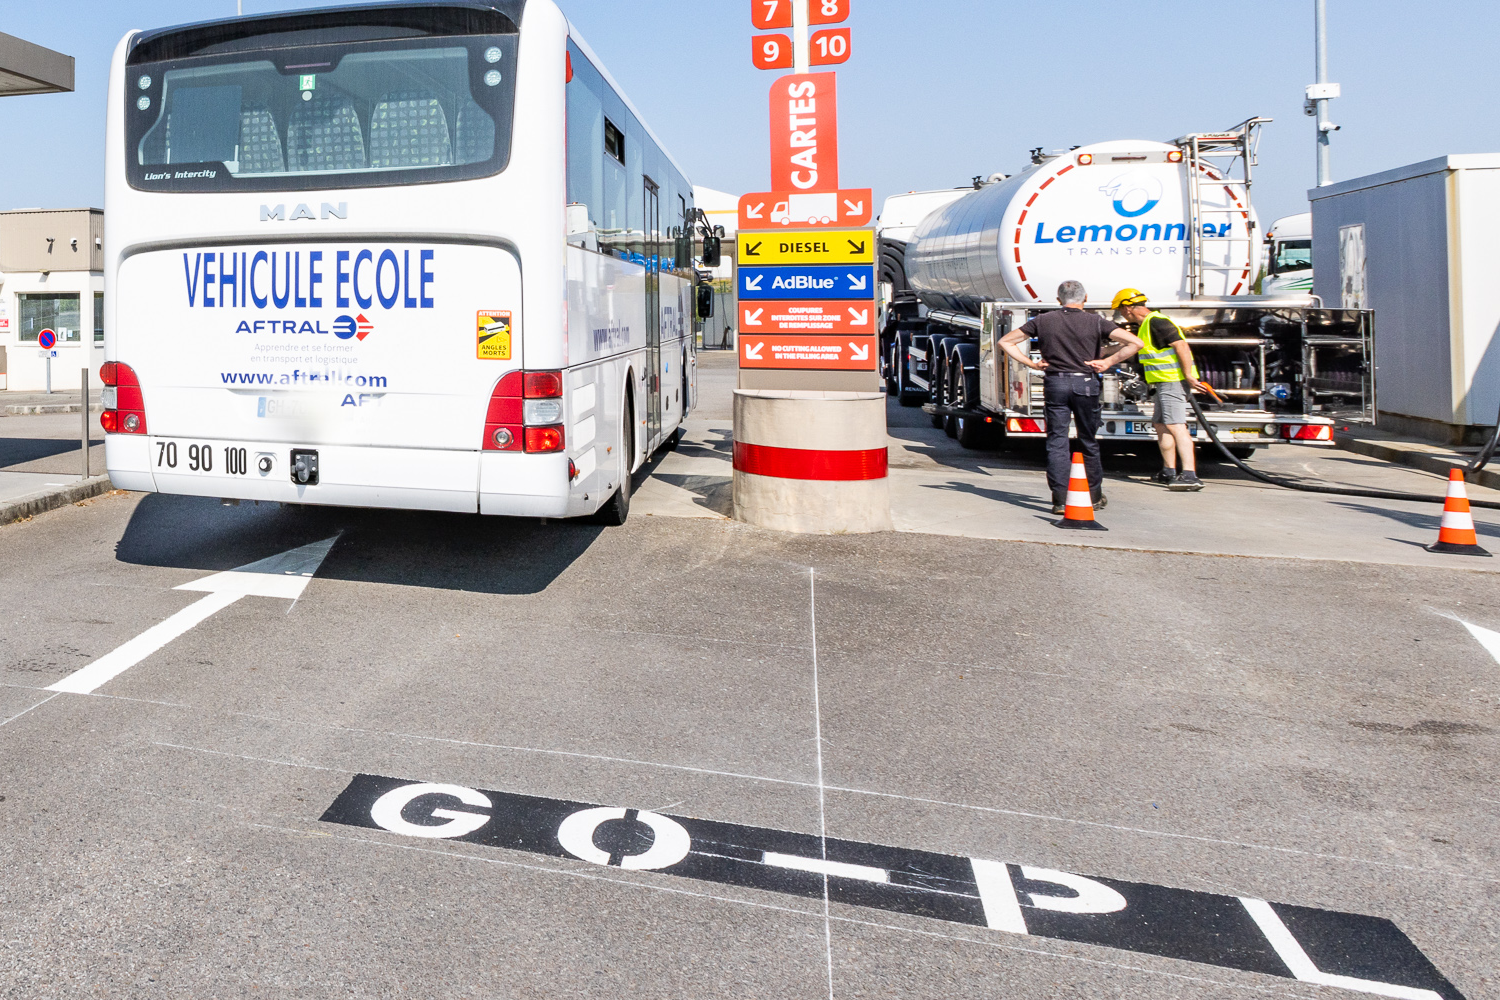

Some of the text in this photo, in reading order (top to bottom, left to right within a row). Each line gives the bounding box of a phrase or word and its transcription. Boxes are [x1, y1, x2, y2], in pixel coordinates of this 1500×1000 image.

[762, 0, 779, 22] 7
[762, 40, 780, 63] 9
[815, 35, 847, 58] 10
[788, 80, 819, 190] CARTES
[144, 169, 217, 181] Lion's Intercity
[259, 201, 348, 222] MAN
[779, 242, 830, 253] DIESEL
[1067, 246, 1201, 256] TRANSPORTS
[182, 249, 435, 310] VEHICULE ECOLE
[235, 320, 329, 334] AFTRAL
[254, 343, 299, 354] Apprendre
[301, 344, 310, 352] et
[323, 343, 354, 352] former
[809, 345, 842, 353] ALLOWED
[250, 354, 358, 366] en transport et logistique
[156, 441, 248, 476] 70 90 100
